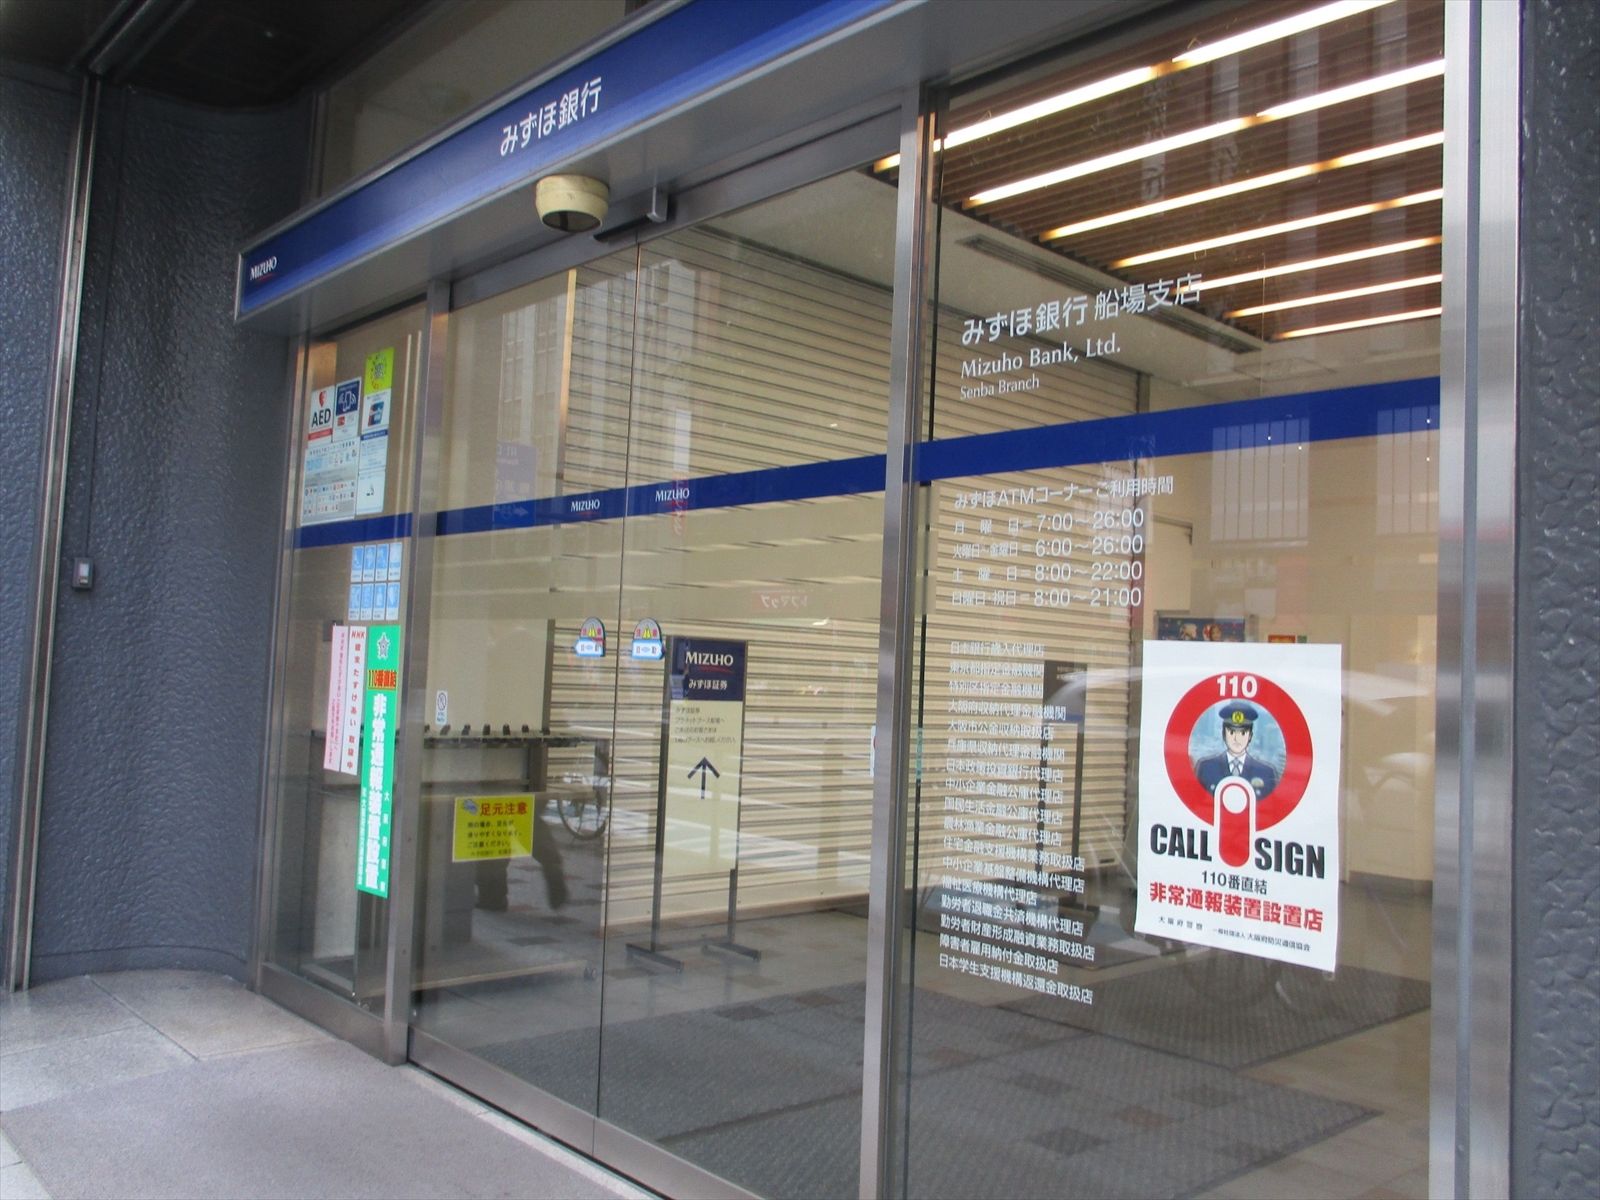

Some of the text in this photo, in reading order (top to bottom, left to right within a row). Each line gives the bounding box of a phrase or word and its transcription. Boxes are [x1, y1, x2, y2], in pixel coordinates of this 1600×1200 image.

[500, 77, 602, 157] みずほ銀行
[250, 255, 278, 281] MIZUHO
[961, 273, 1203, 346] みずほ銀行 船場支店
[960, 333, 1121, 379] Mizuho Bank, Ltd.
[960, 373, 1040, 400] Senba Branch
[311, 408, 332, 428] AED
[570, 499, 601, 513] MIZUHO
[655, 487, 690, 502] MIZUHO
[685, 651, 734, 666] MIZUHO
[688, 678, 728, 691] みずほ証券
[1216, 675, 1258, 698] 110
[948, 719, 1055, 741] 大阪市公金収納取扱店
[945, 778, 1064, 804] 中小企業金融公庫代理店
[481, 801, 528, 816] 足元注意
[944, 797, 1063, 825] 国民生活金融公庫代理店
[943, 816, 1063, 847] 農林漁業金融公庫代理店
[943, 835, 1086, 873] 住宅金融支援機構業務取扱店
[1150, 824, 1325, 880] CALL SIGN
[942, 856, 1086, 894] 中小企業基盤整備機構代理店
[1201, 870, 1268, 896] 110番直結
[942, 875, 1038, 906] 福祉医療機構代理店
[941, 894, 1084, 937] 勤労者退職金共済機構代理店
[1150, 881, 1323, 933] 非常通報装置設置店
[940, 913, 1096, 962] 勤労者財産形成融資業務取扱店
[939, 933, 1060, 975] 障害者雇用納付金取扱店
[939, 953, 1094, 1005] 日本学生支援機構返還金取扱店
